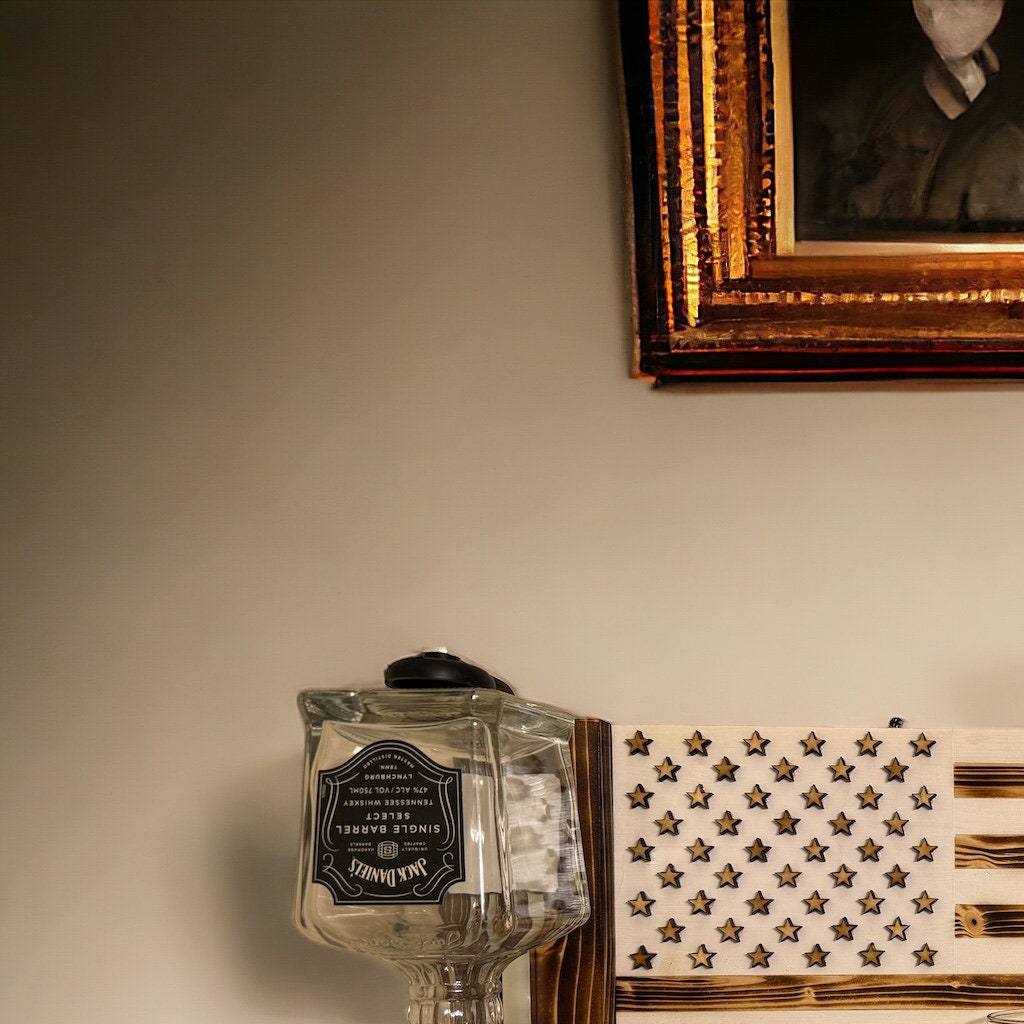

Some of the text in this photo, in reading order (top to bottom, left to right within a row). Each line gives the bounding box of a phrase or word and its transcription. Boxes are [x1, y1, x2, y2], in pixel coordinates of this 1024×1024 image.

[393, 754, 415, 769] MASTER
[366, 812, 410, 820] SELECT
[336, 824, 441, 834] SINGLE BARREL
[348, 857, 429, 887] JACK DANIEL'S
